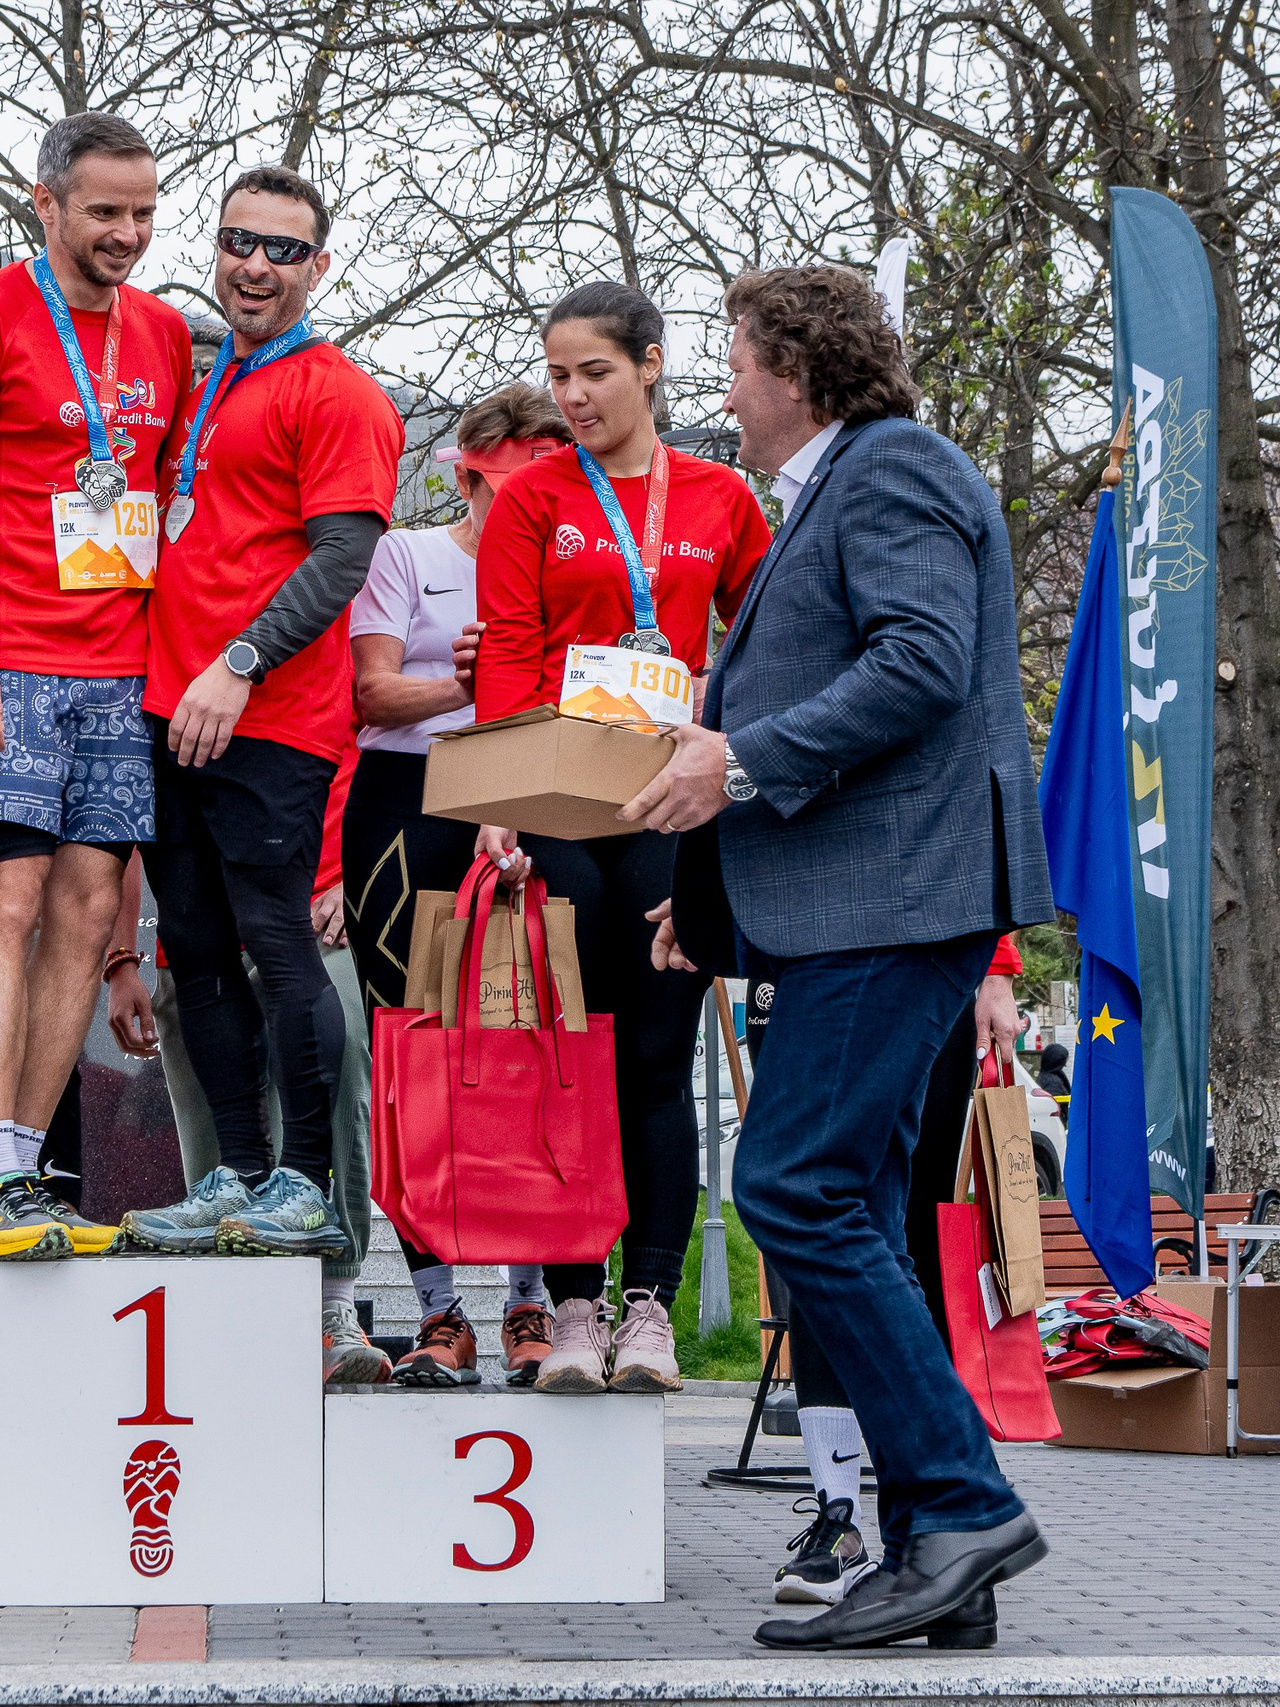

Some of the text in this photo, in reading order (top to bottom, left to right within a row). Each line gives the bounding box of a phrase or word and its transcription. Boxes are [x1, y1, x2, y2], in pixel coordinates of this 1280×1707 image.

[145, 412, 166, 428] Bank
[59, 522, 76, 533] 12K
[111, 501, 155, 537] 1291
[679, 541, 717, 564] Bank
[570, 670, 586, 680] 12K
[629, 660, 690, 706] 1301
[479, 981, 513, 1004] Pirin
[747, 1016, 770, 1025] ProCredi
[111, 1285, 195, 1427] 1
[452, 1429, 535, 1573] 3
